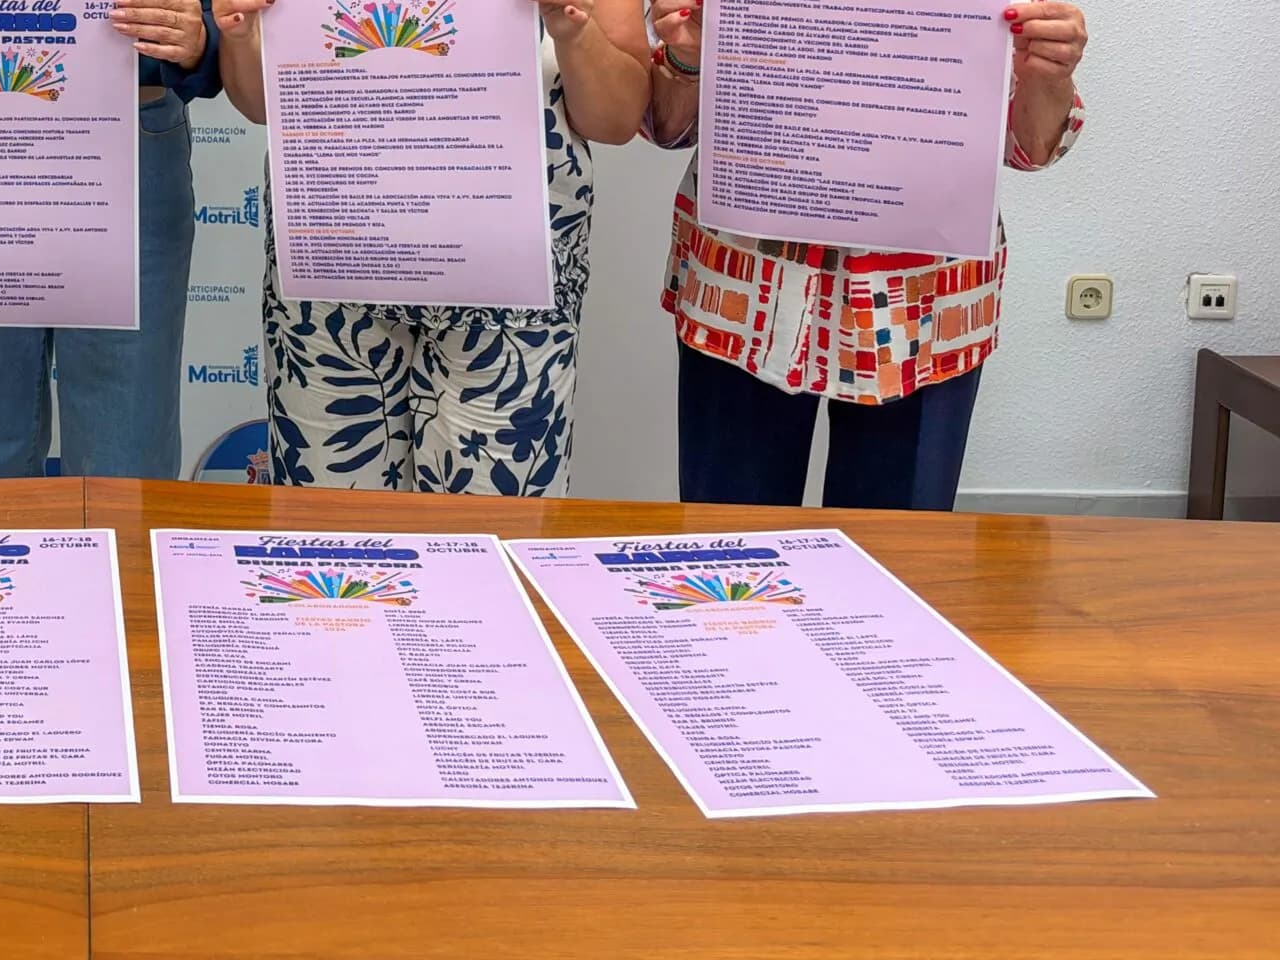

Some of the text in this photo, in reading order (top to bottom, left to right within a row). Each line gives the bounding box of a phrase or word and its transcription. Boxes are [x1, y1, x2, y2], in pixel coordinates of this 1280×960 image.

[83, 12, 110, 20] OCTU
[2, 36, 76, 44] PASTORA
[258, 536, 393, 548] Fiestas del
[612, 538, 746, 553] Fiestas del
[234, 545, 419, 560] BARRIO
[595, 547, 779, 565] BARRIO
[687, 561, 790, 570] PASTORA
